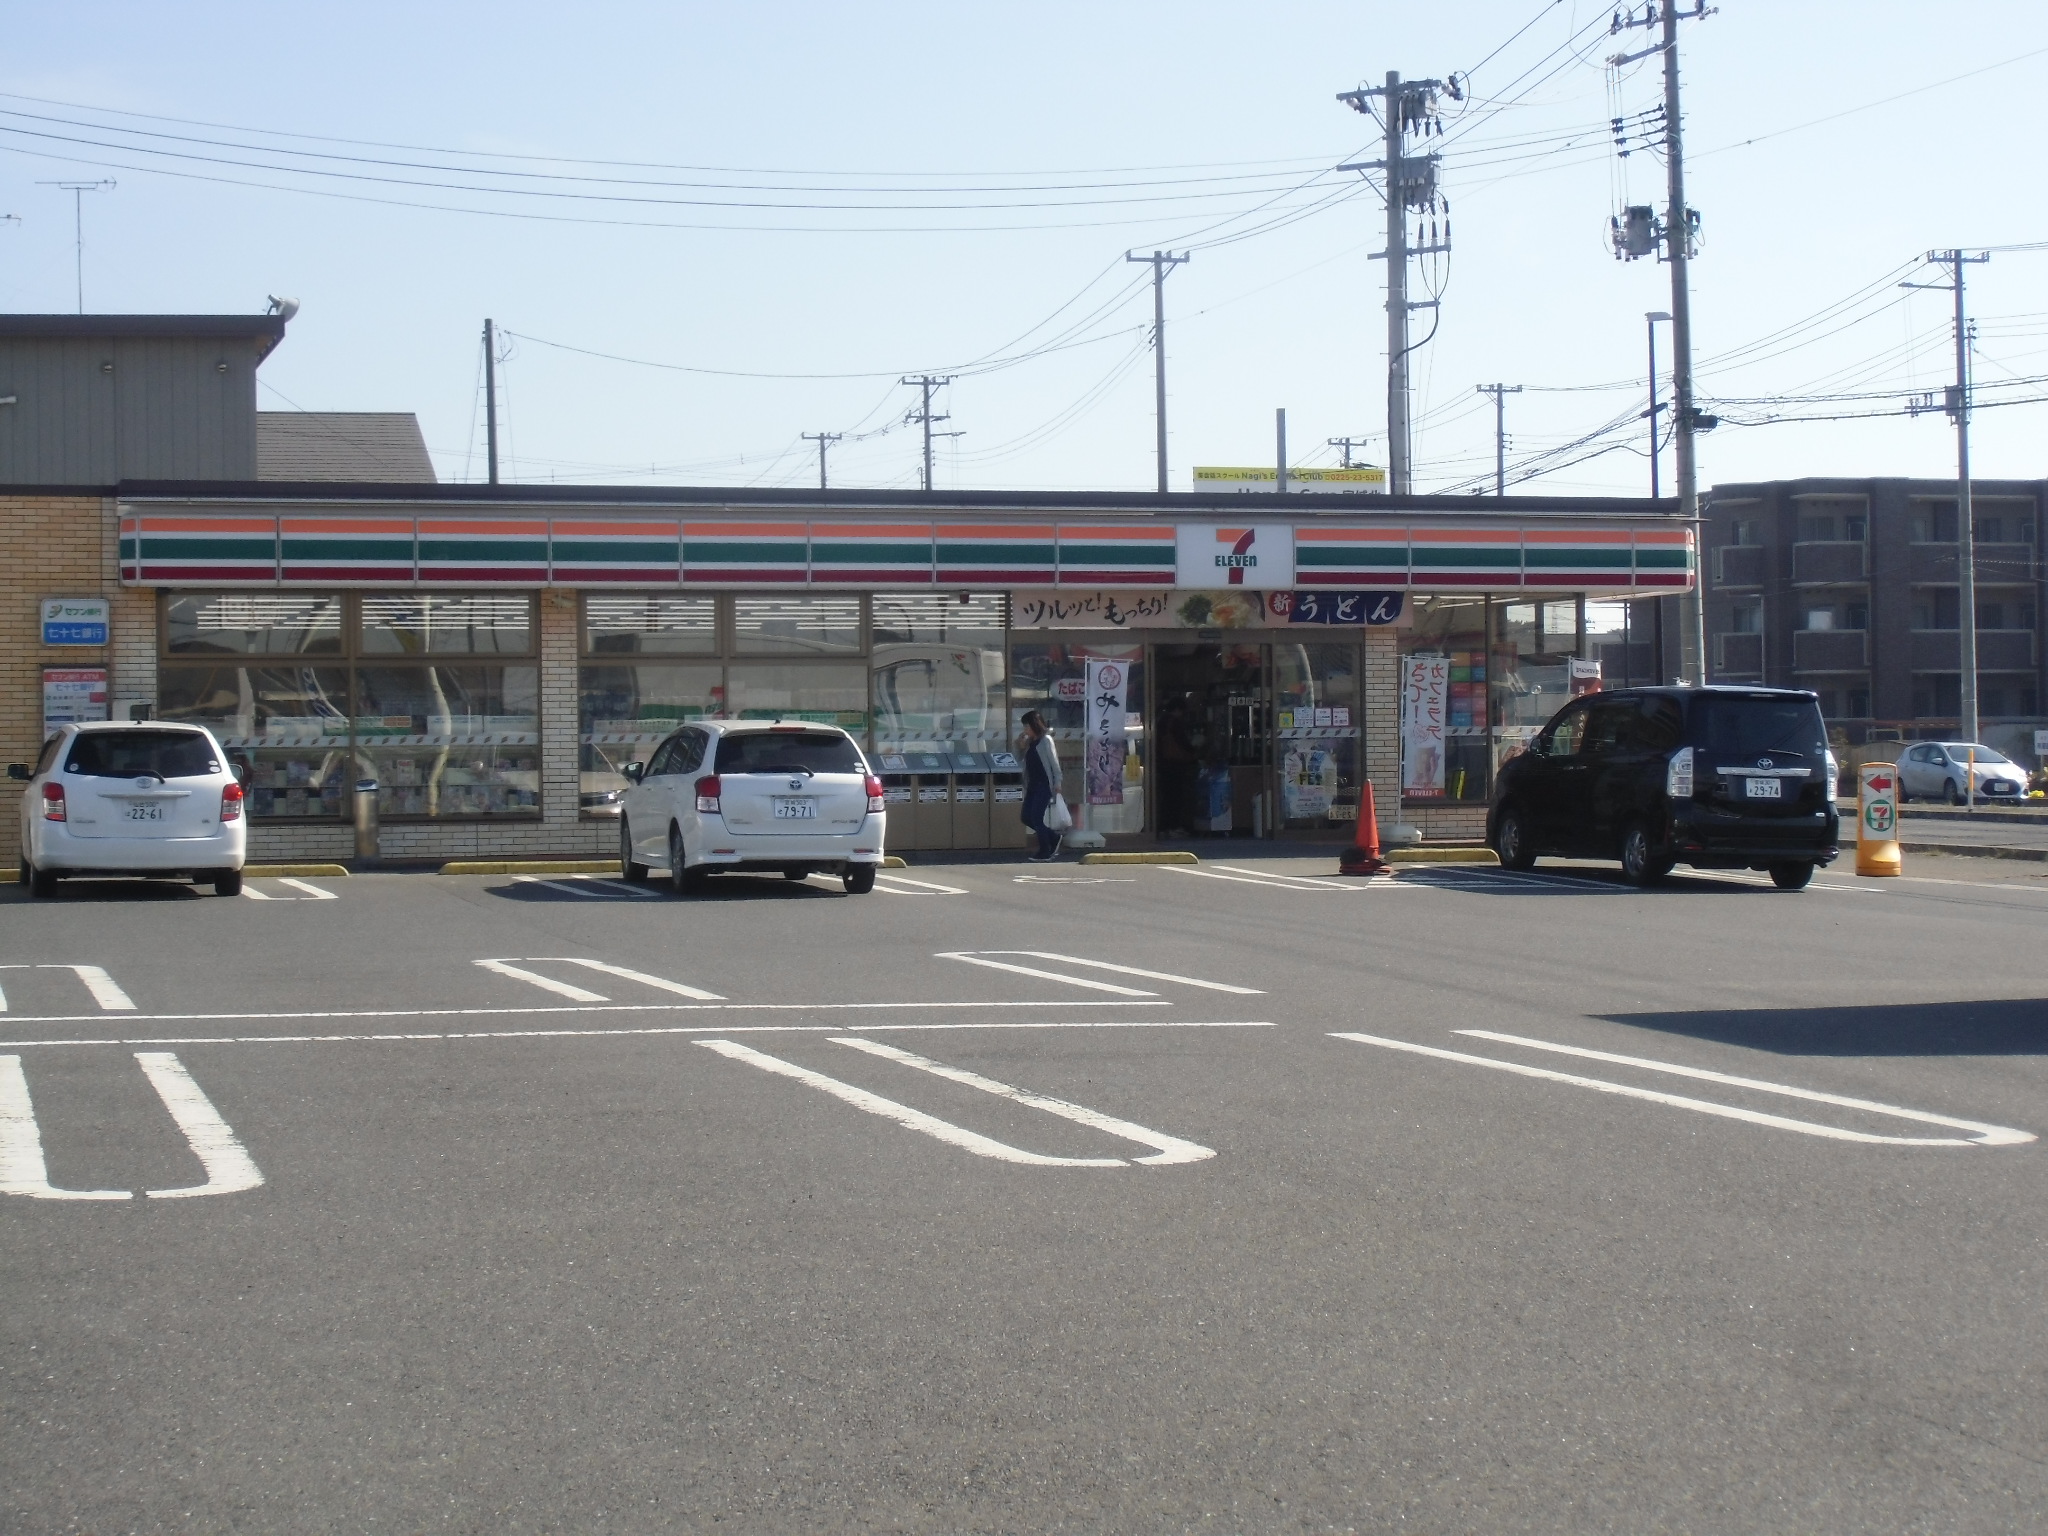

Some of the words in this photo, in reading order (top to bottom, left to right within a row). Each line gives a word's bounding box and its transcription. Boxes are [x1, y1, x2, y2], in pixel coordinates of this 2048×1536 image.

[1273, 593, 1292, 612] 新
[1300, 594, 1396, 621] うどん
[47, 627, 103, 639] 七十七銀行
[1754, 785, 1779, 796] 29-74
[131, 808, 163, 820] 22-61
[783, 806, 812, 817] 79-71
